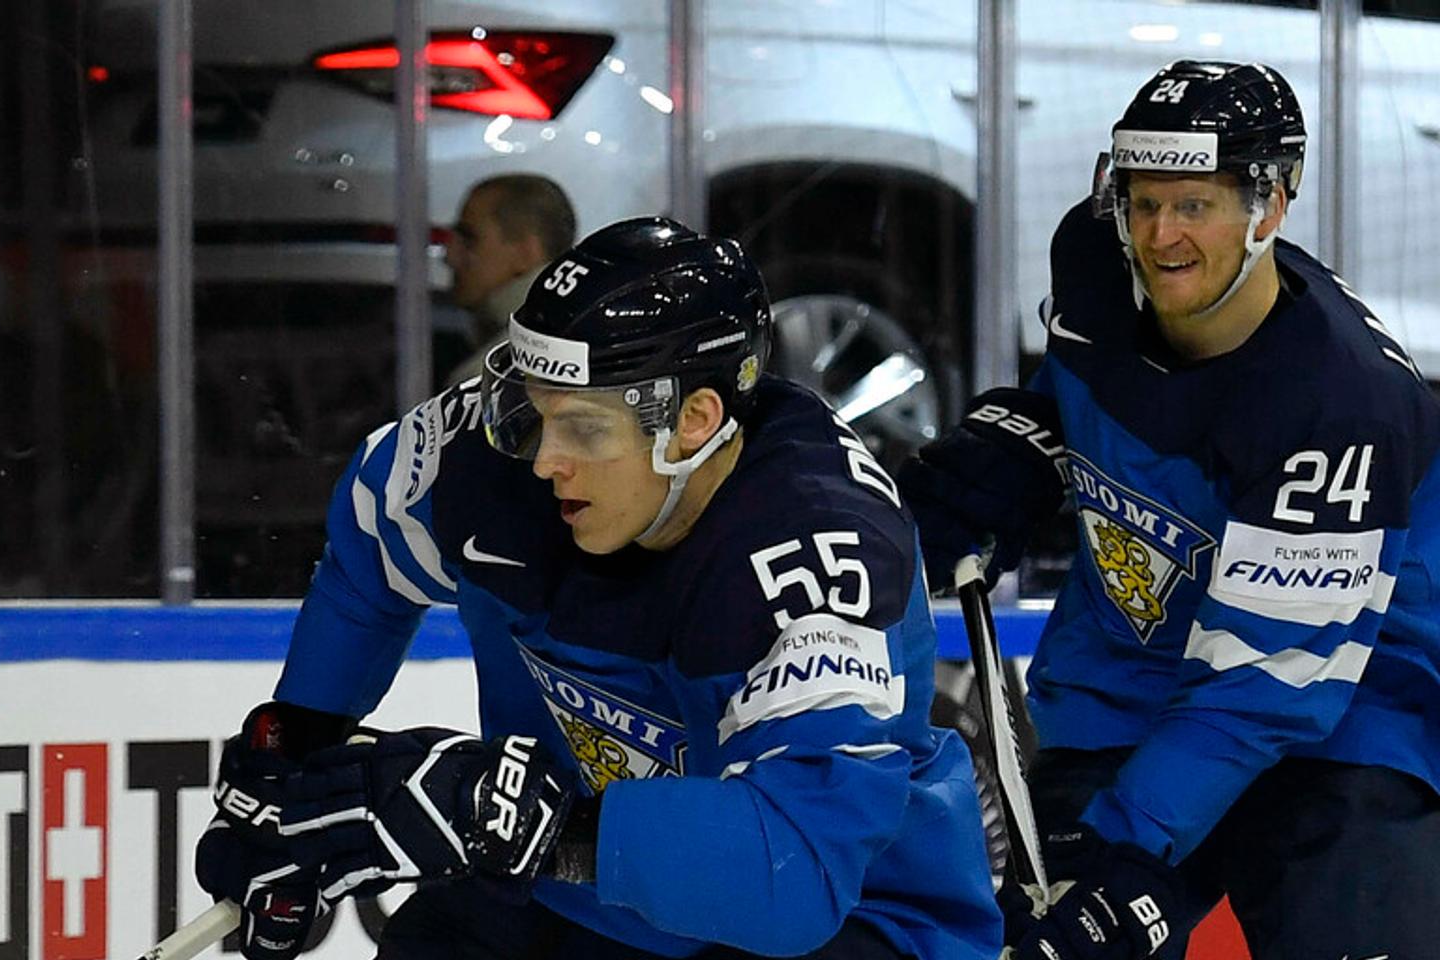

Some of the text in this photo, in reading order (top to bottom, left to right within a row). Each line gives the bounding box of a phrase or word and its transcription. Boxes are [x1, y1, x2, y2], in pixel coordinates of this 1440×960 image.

[1149, 79, 1190, 103] 24
[1116, 148, 1210, 166] FINNAIR
[543, 260, 589, 297] 55
[511, 344, 581, 379] NNAIR
[1272, 444, 1375, 525] 24
[1071, 465, 1183, 548] SUOMI
[1274, 547, 1359, 561] FLYING WITH
[750, 531, 871, 630] 55
[1223, 561, 1373, 590] FINNAIR
[782, 630, 835, 652] FLYING
[741, 654, 890, 705] FINNAIR
[486, 735, 538, 842] UER
